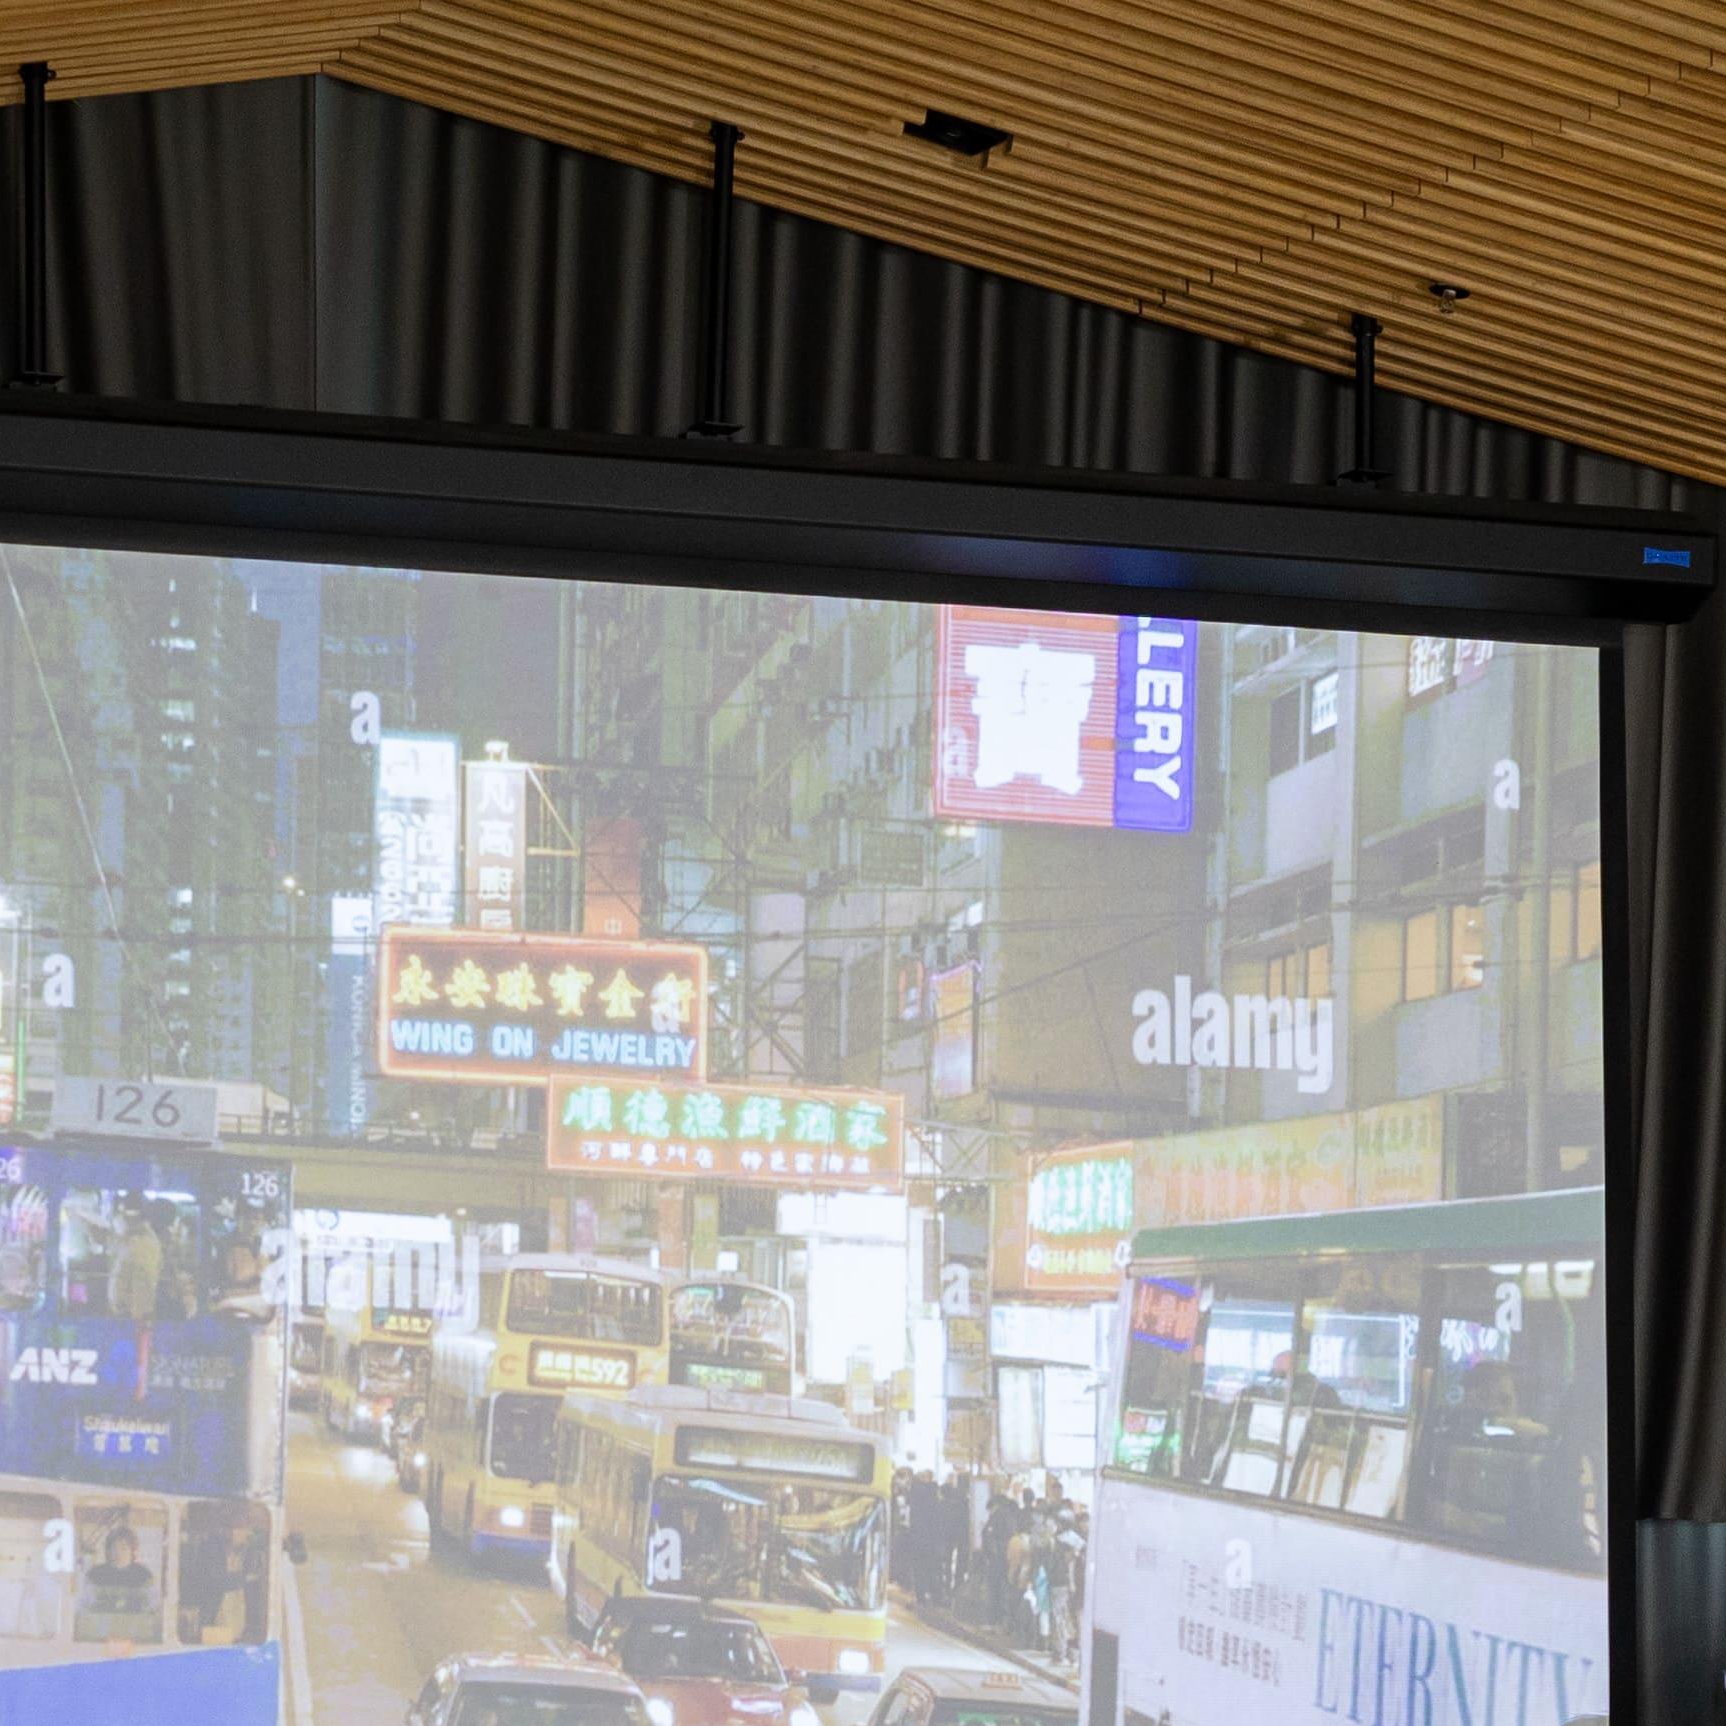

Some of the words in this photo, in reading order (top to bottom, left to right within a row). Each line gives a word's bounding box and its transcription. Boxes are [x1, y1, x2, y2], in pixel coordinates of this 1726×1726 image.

[391, 1020, 473, 1056] WING
[492, 1026, 534, 1059] ON
[551, 1030, 697, 1067] JEWELRY
[1131, 974, 1335, 1094] alamy
[96, 1083, 181, 1128] 126
[242, 1172, 279, 1198] 126
[10, 1348, 98, 1385] ANZ
